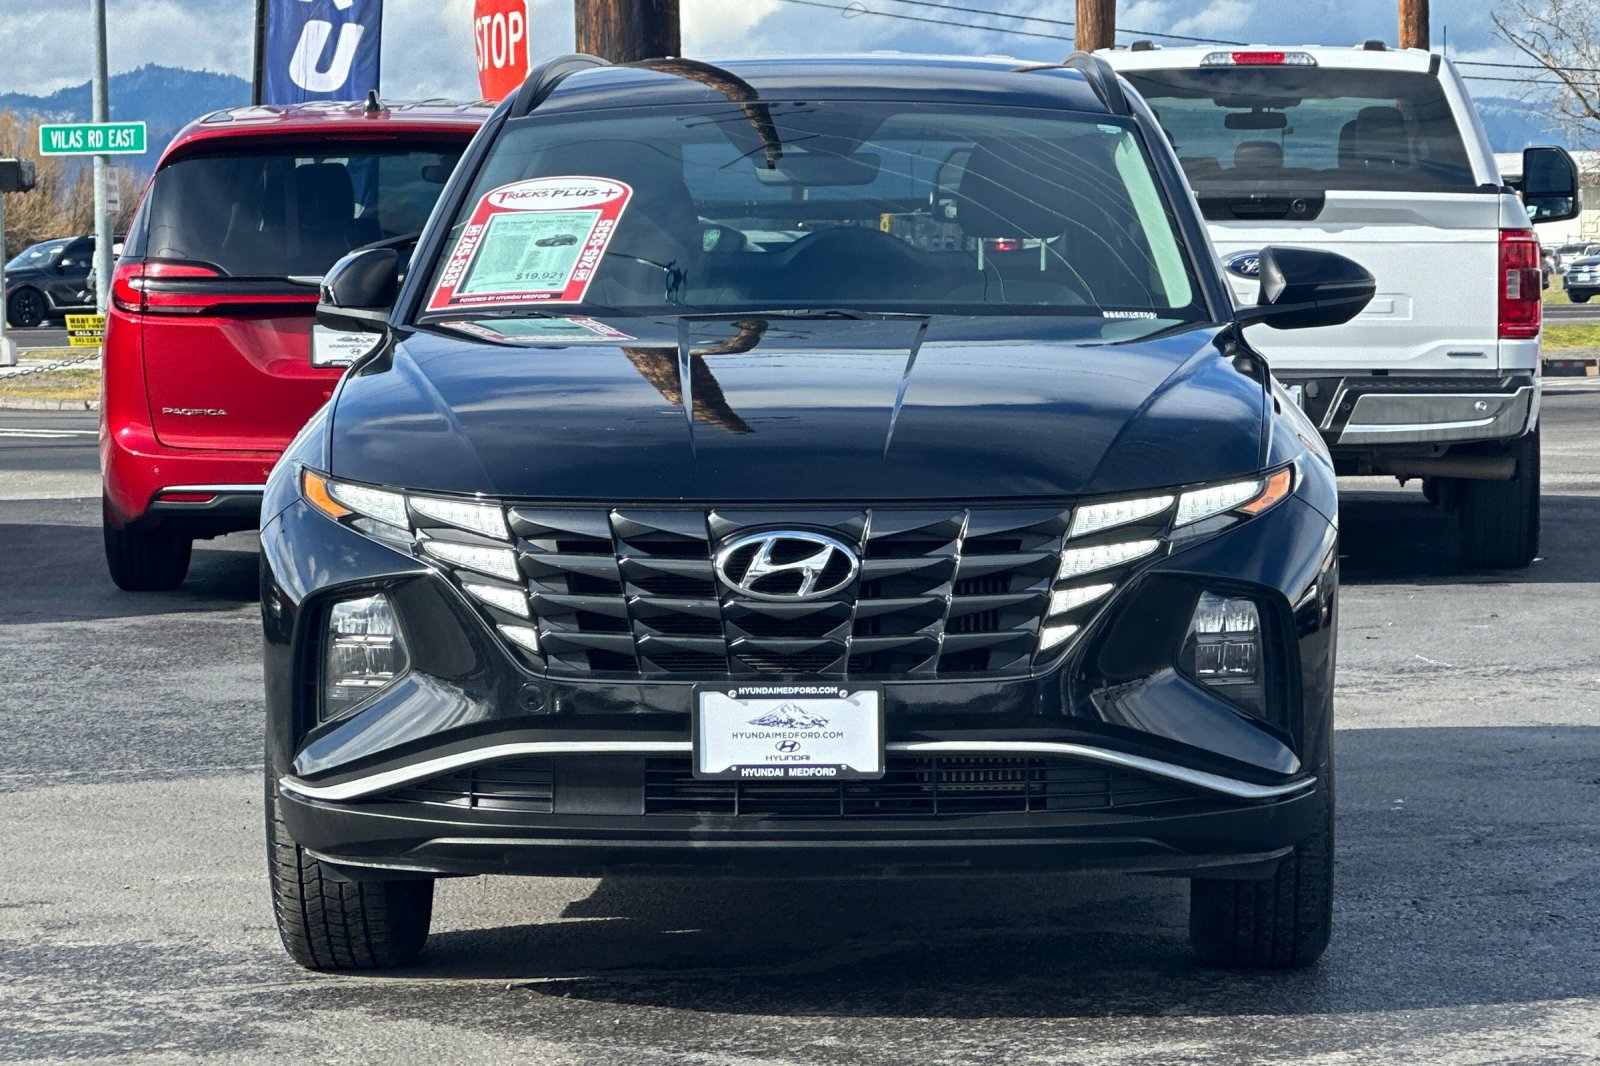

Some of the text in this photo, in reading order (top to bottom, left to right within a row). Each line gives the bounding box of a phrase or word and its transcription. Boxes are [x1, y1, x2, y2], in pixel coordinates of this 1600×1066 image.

[289, 0, 365, 93] U
[475, 11, 524, 72] STOP
[51, 129, 136, 149] VILAS RD EAST
[578, 219, 614, 274] 245-5335
[441, 235, 477, 288] 245-5335
[515, 271, 565, 281] $19,921
[459, 295, 488, 303] POWERED
[162, 407, 228, 416] PACIFICA
[738, 686, 838, 695] HYUNDAIMEDFORD.COM
[732, 731, 844, 740] HYUNDAIMEDFORD.COM
[765, 754, 811, 762] HYUNDAI
[741, 767, 837, 777] HYUNDAI MEDFORD
